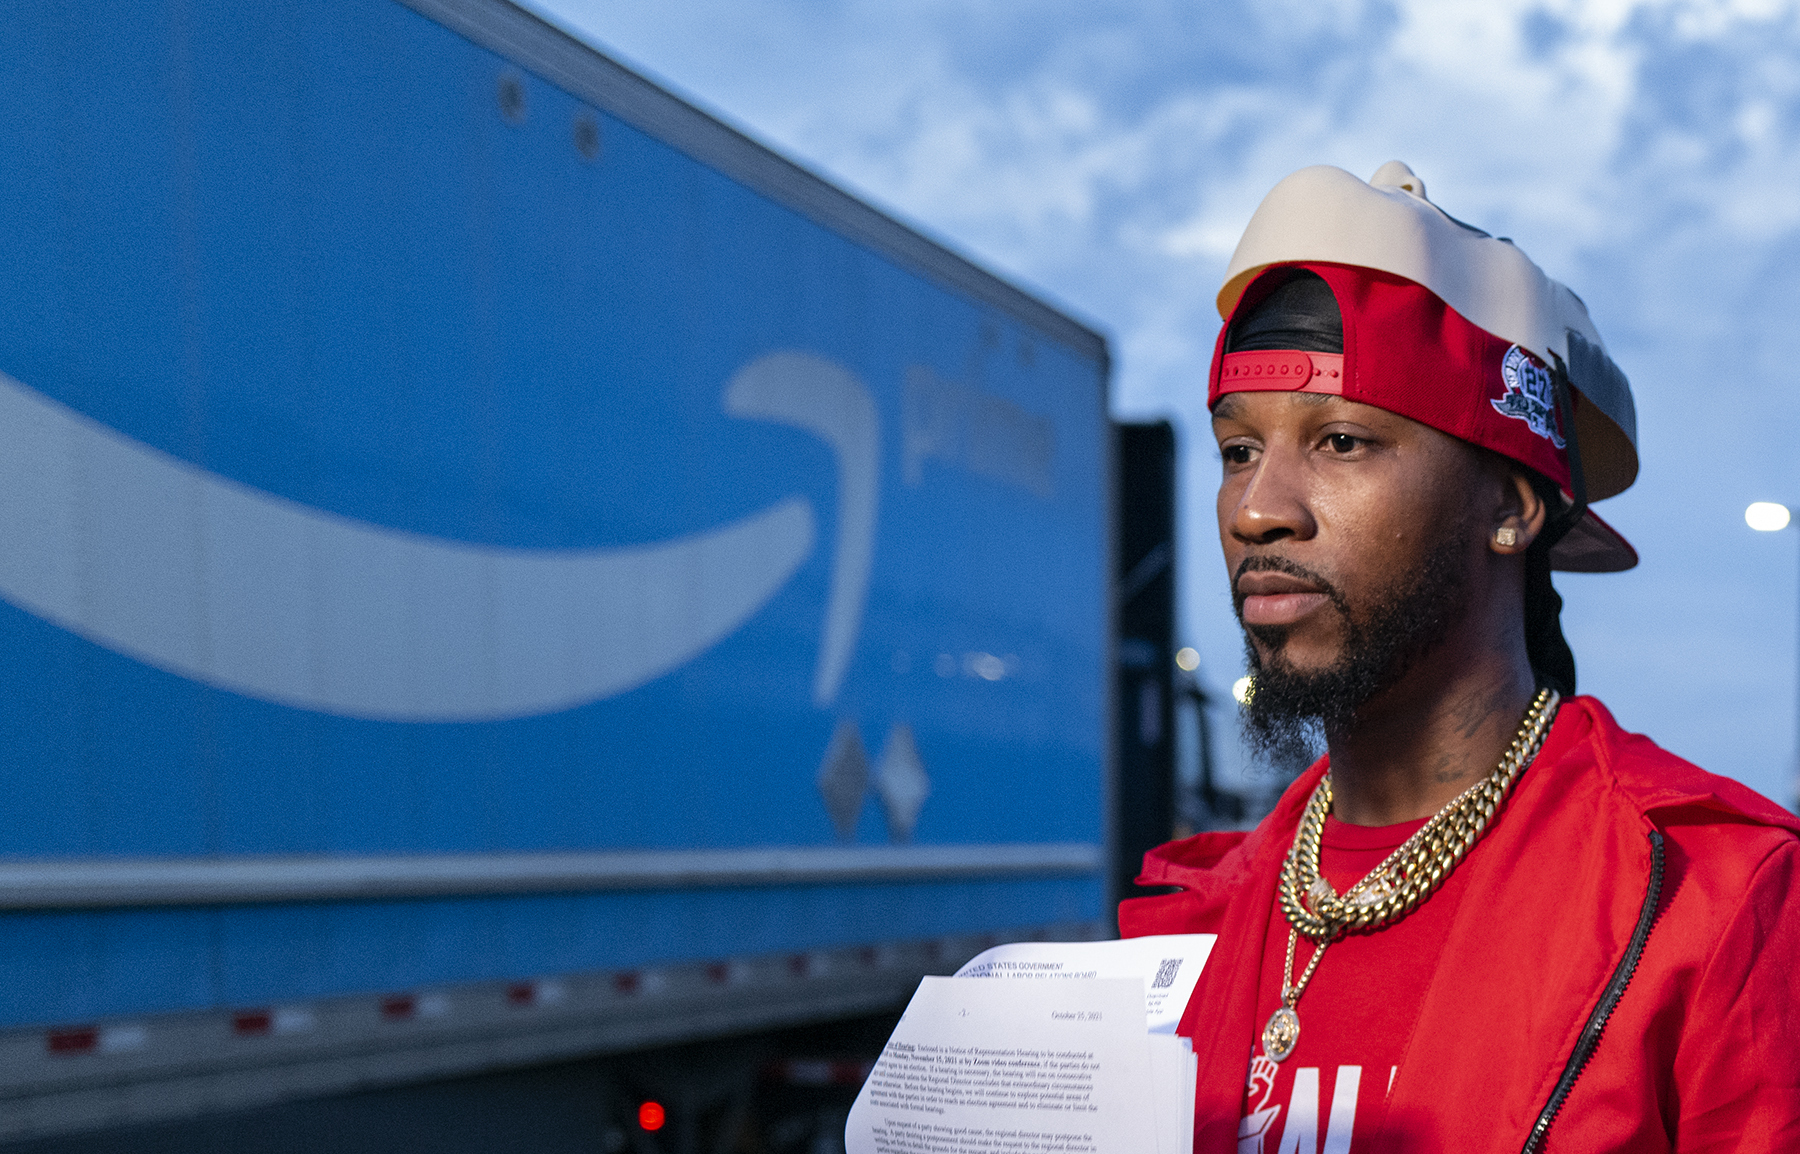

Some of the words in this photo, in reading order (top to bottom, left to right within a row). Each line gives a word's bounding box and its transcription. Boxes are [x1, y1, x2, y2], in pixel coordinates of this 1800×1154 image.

[1525, 367, 1546, 402] 27
[987, 962, 1018, 972] STATES
[1018, 962, 1064, 972] GOVERNMENT
[1051, 1010, 1075, 1021] October
[944, 1056, 957, 1064] 2021
